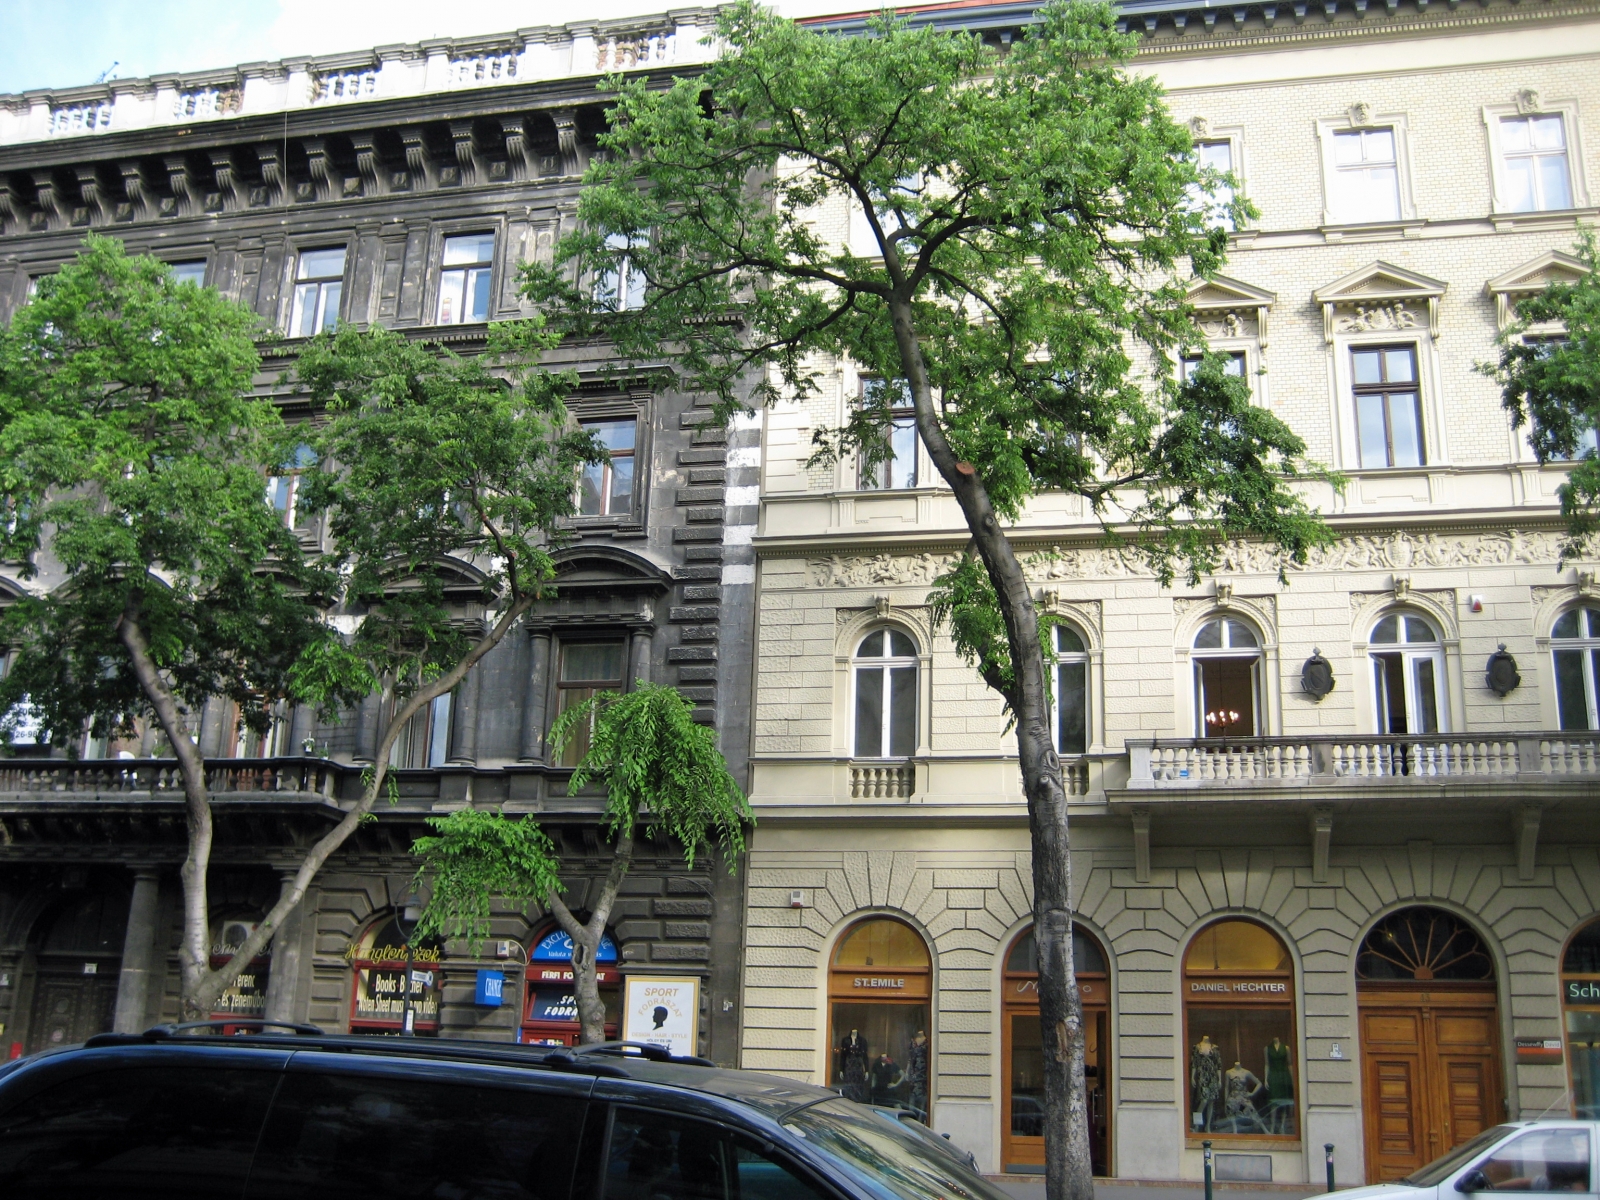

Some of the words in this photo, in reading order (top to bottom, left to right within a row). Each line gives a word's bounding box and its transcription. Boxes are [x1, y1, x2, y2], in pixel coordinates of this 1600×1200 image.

[375, 973, 396, 993] Books
[485, 977, 502, 998] CHANGE
[854, 977, 904, 988] ST.EMILE
[1191, 982, 1230, 992] DANIEL
[1232, 983, 1286, 992] HECHTER
[644, 987, 679, 997] SPORT
[638, 997, 683, 1017] FODRÁSZAT
